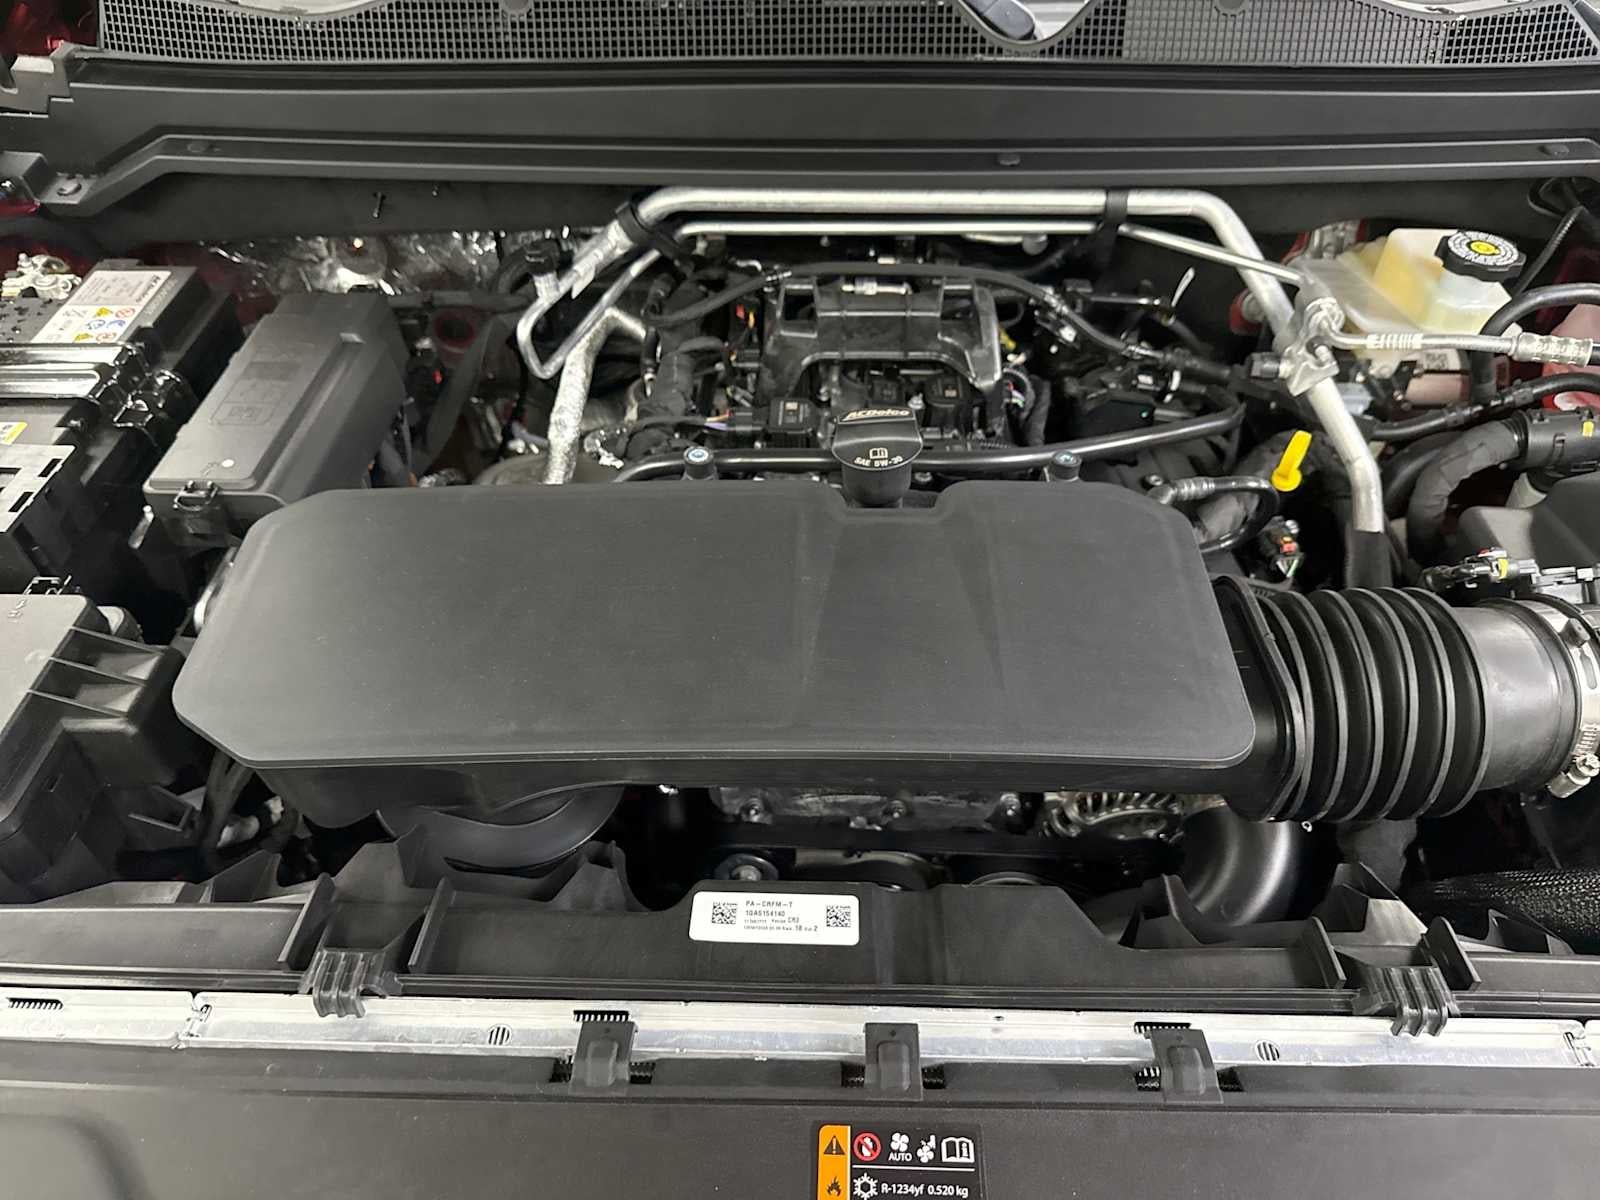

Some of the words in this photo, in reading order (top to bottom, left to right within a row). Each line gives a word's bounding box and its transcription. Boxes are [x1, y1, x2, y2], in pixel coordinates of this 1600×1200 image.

[842, 409, 910, 421] ACDelco
[854, 457, 871, 467] SAE
[888, 1152, 913, 1162] AUTO
[881, 1183, 925, 1197] R-1234yf
[927, 1184, 955, 1196] 0.520
[956, 1186, 969, 1198] kg
